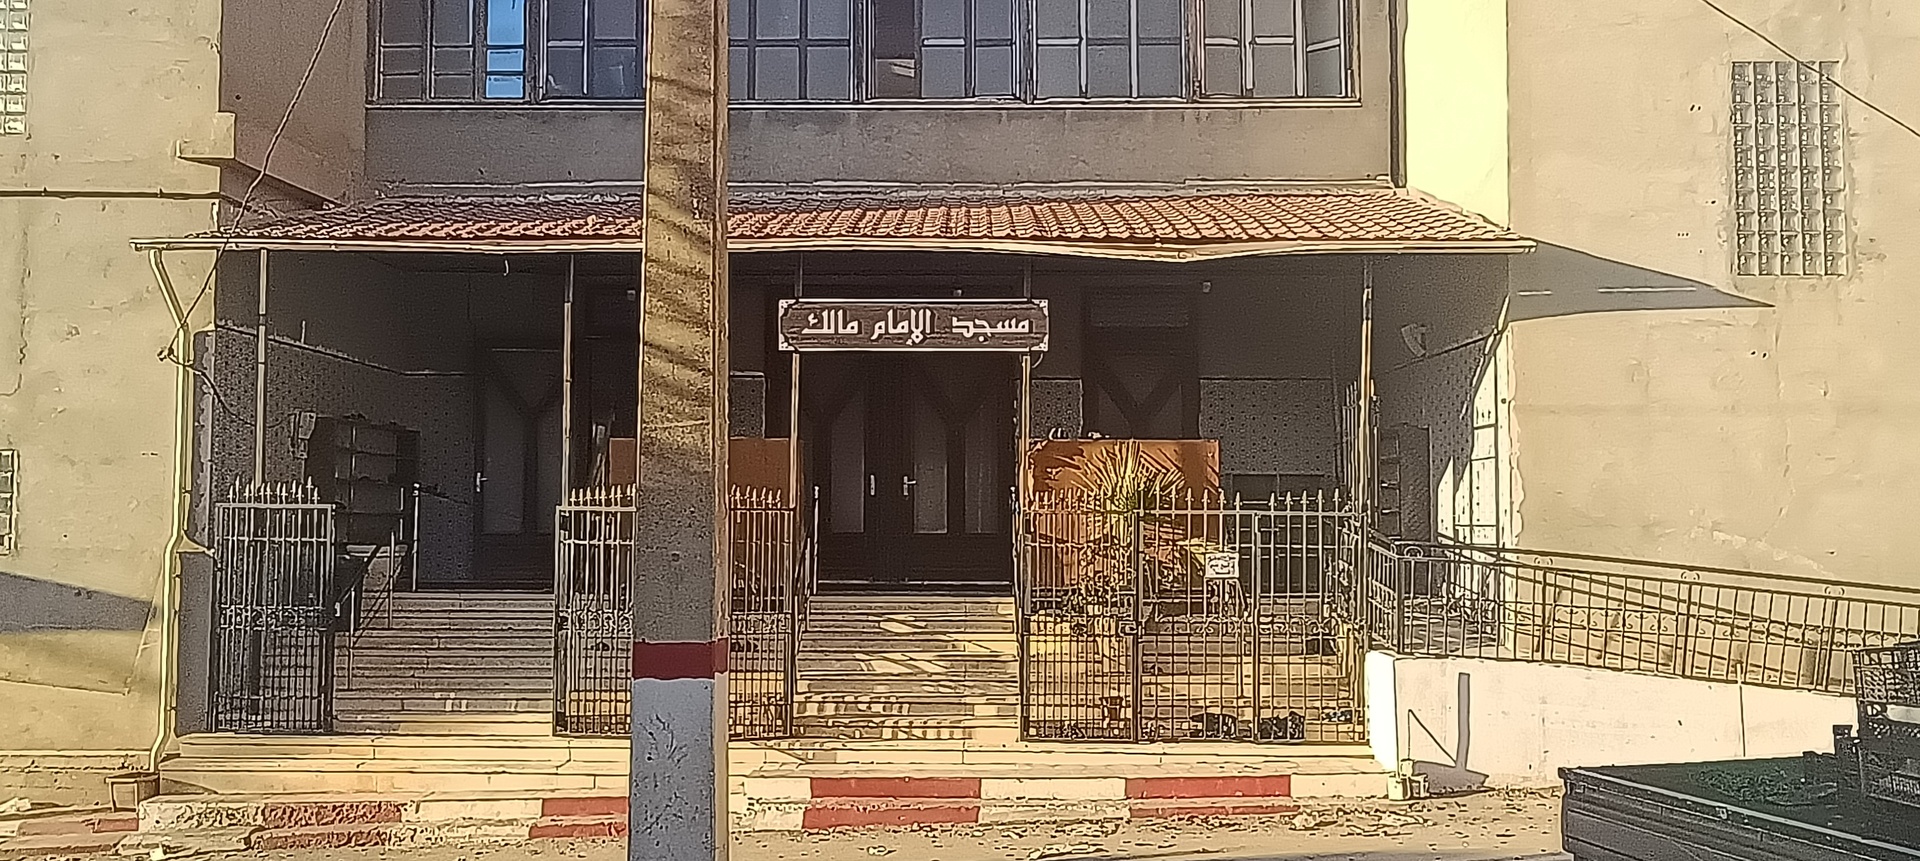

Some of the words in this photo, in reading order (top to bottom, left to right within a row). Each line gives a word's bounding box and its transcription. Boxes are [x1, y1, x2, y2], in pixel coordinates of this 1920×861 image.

[801, 309, 859, 334] مالك
[870, 309, 932, 346] الإمام
[951, 316, 1030, 343] مسجد
